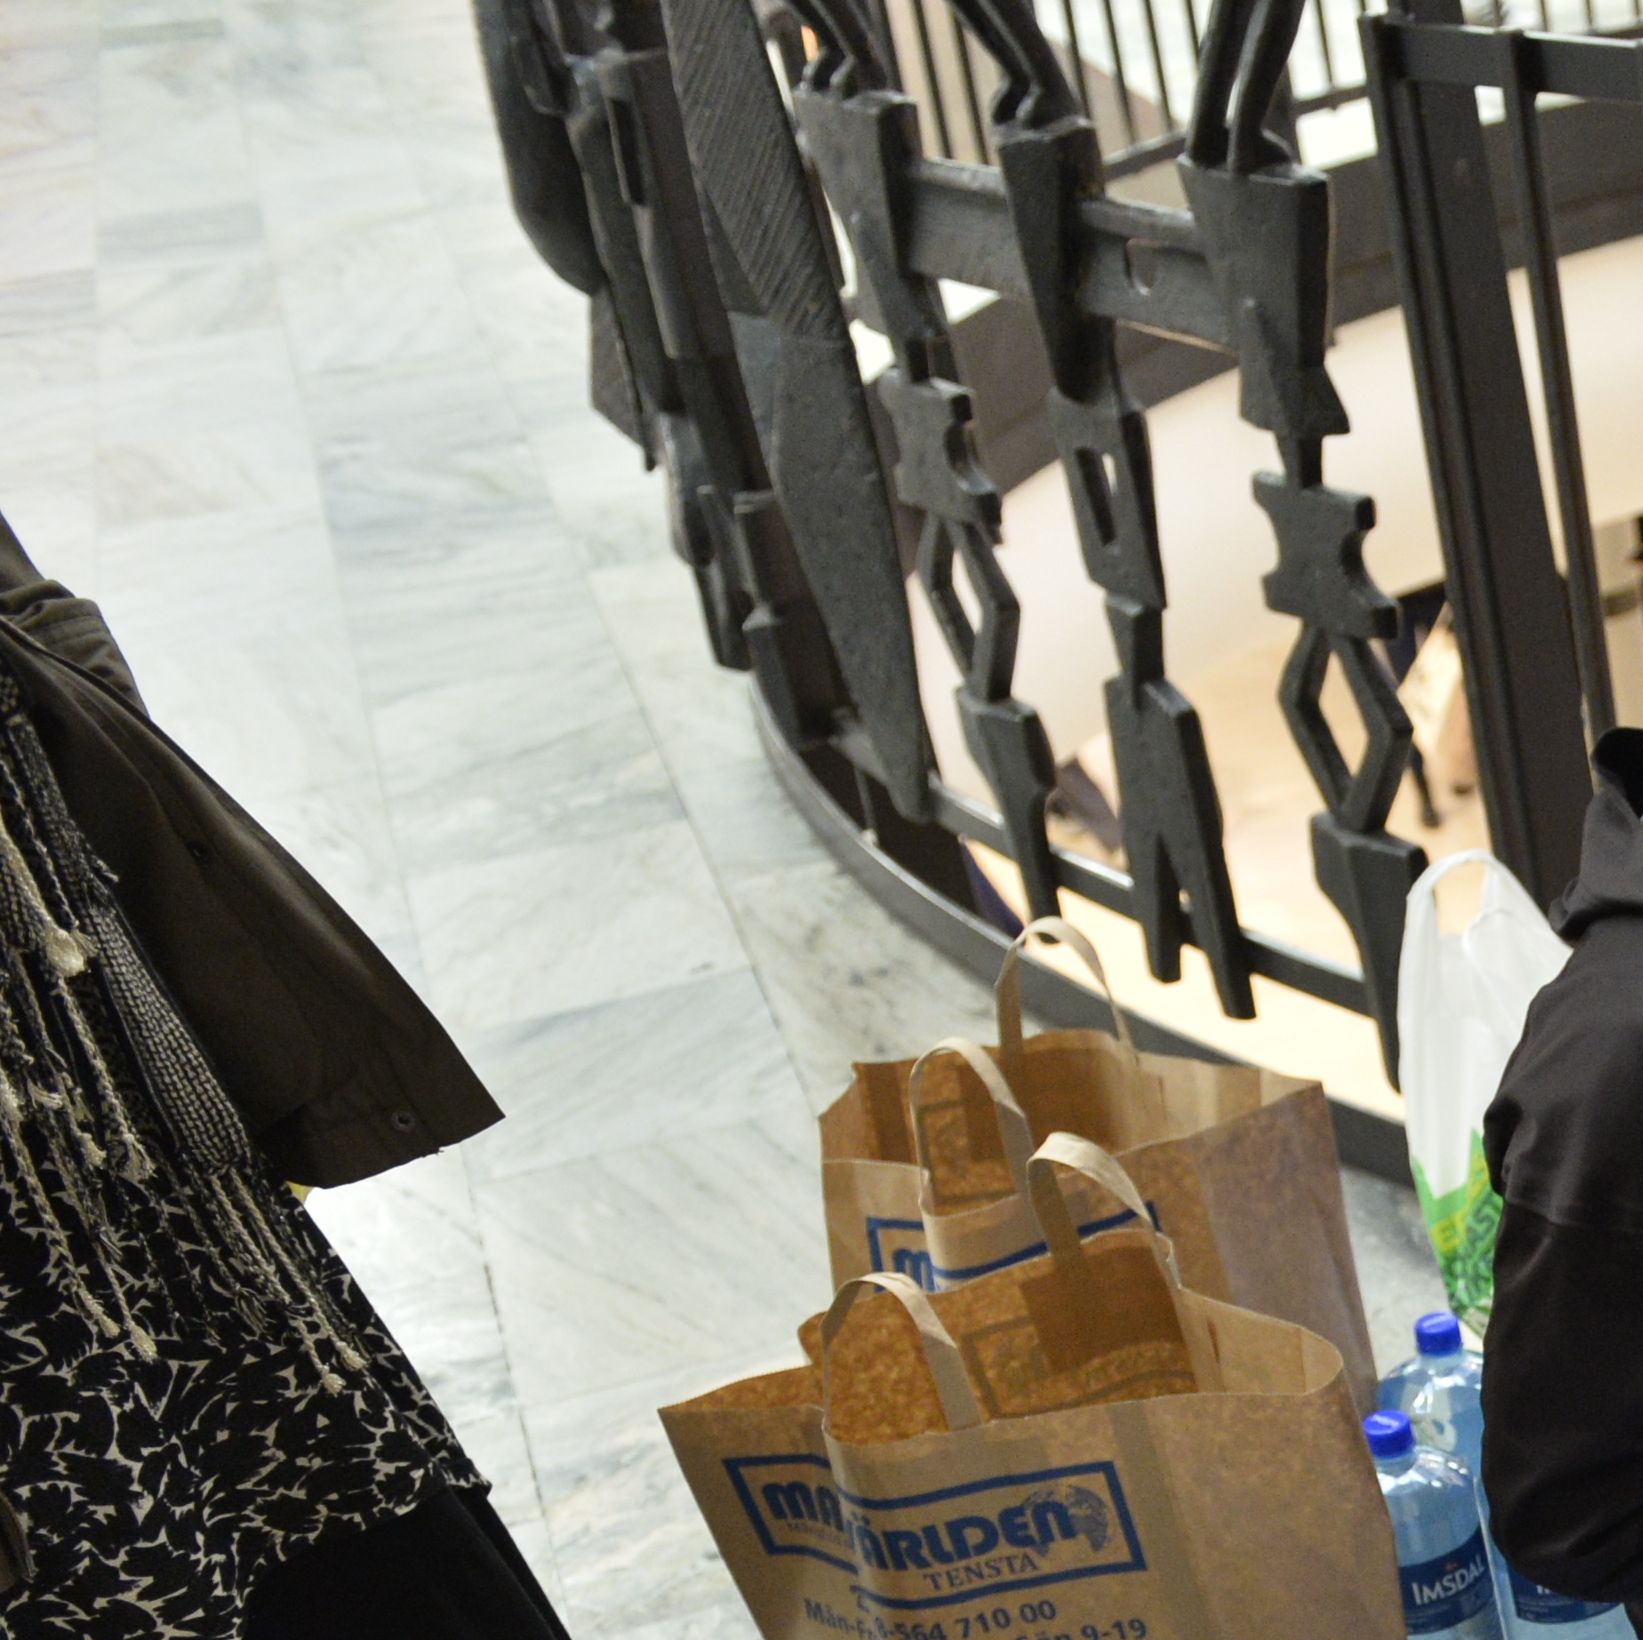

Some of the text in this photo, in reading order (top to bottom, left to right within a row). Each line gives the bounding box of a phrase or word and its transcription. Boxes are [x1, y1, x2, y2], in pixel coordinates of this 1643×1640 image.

[924, 1551, 1041, 1592] TENSTA
[1411, 1553, 1486, 1606] IMSDAL
[955, 1607, 1012, 1640] 710
[1019, 1600, 1057, 1624] 00
